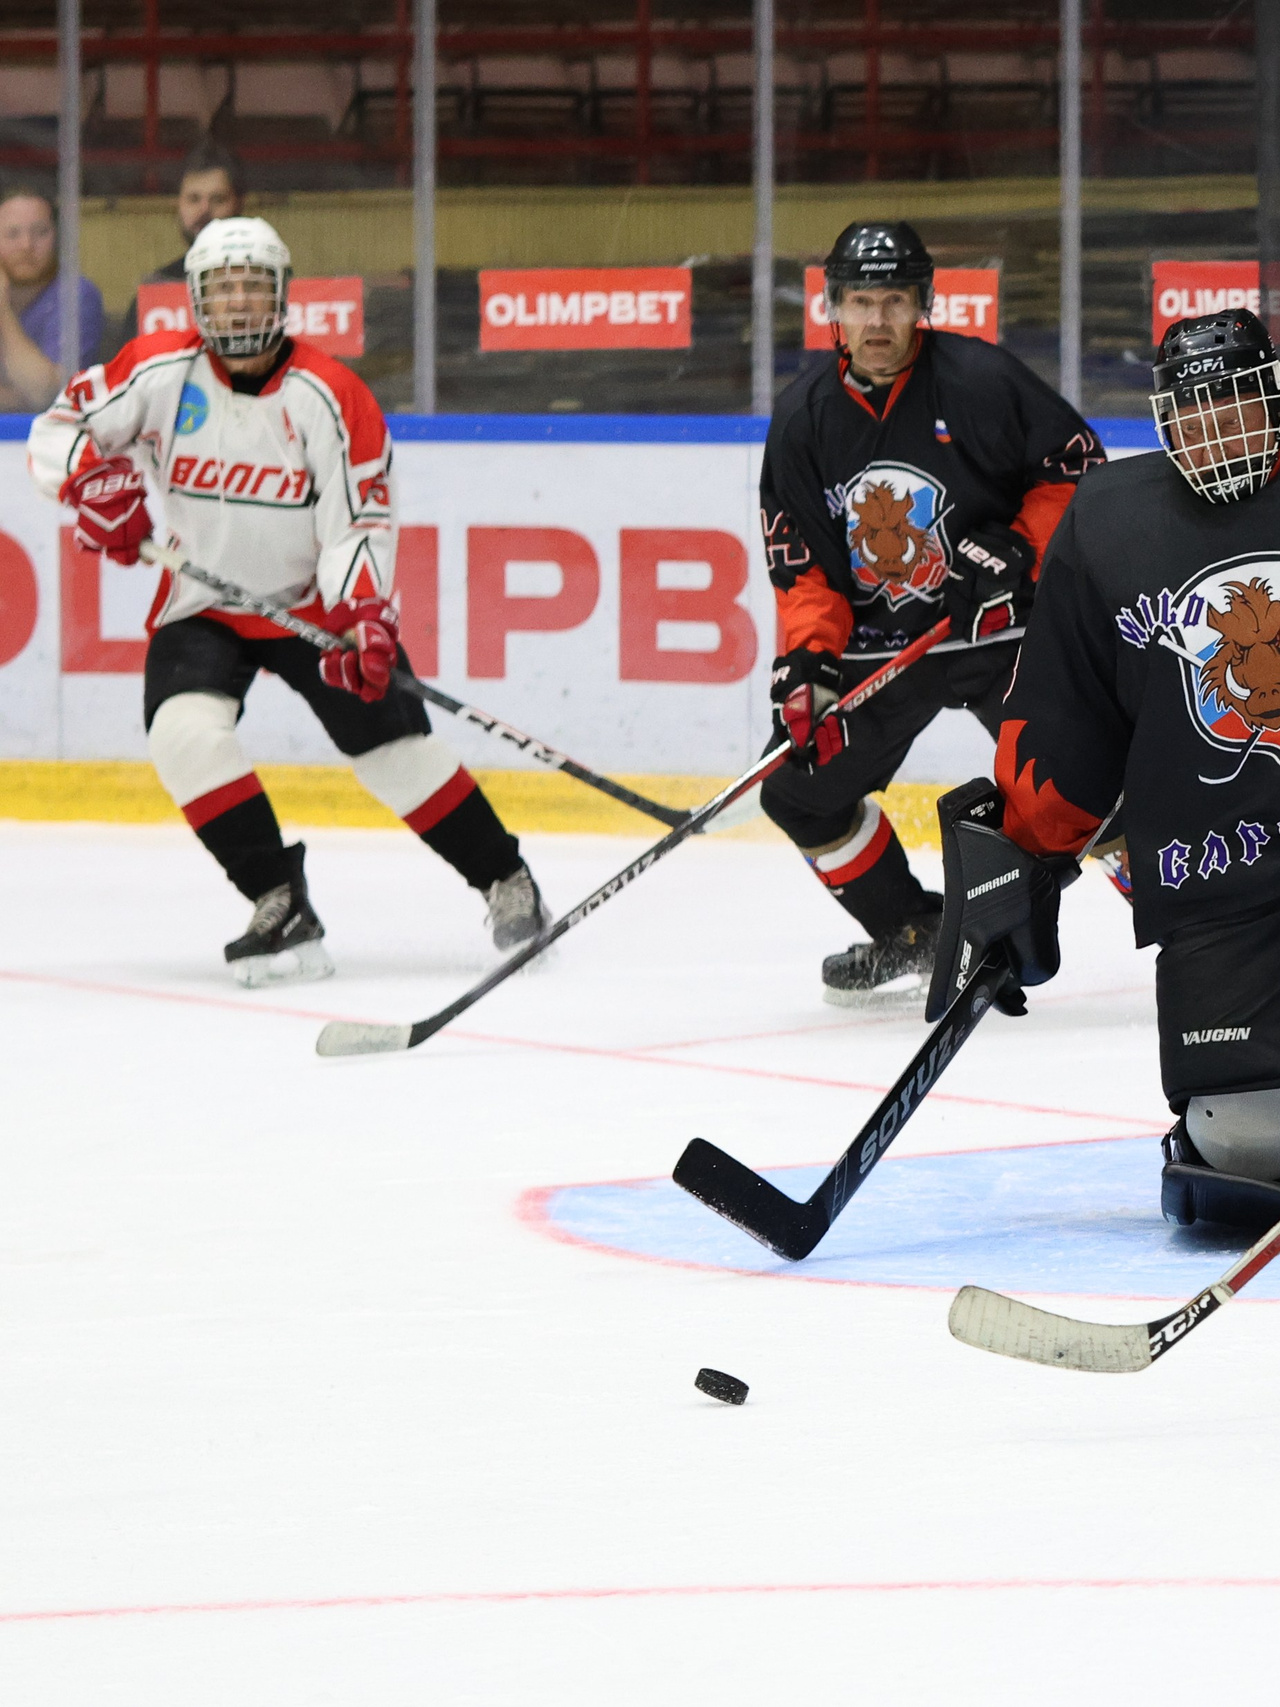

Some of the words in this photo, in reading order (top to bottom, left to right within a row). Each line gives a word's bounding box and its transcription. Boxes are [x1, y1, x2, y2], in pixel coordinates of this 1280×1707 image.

[485, 291, 685, 324] OLIMPBET
[1176, 355, 1225, 379] JOFA
[1115, 587, 1206, 649] WILD
[966, 867, 1021, 901] WARRIOR
[1181, 1026, 1252, 1047] VAUGHN
[859, 1024, 955, 1175] SOYUZ
